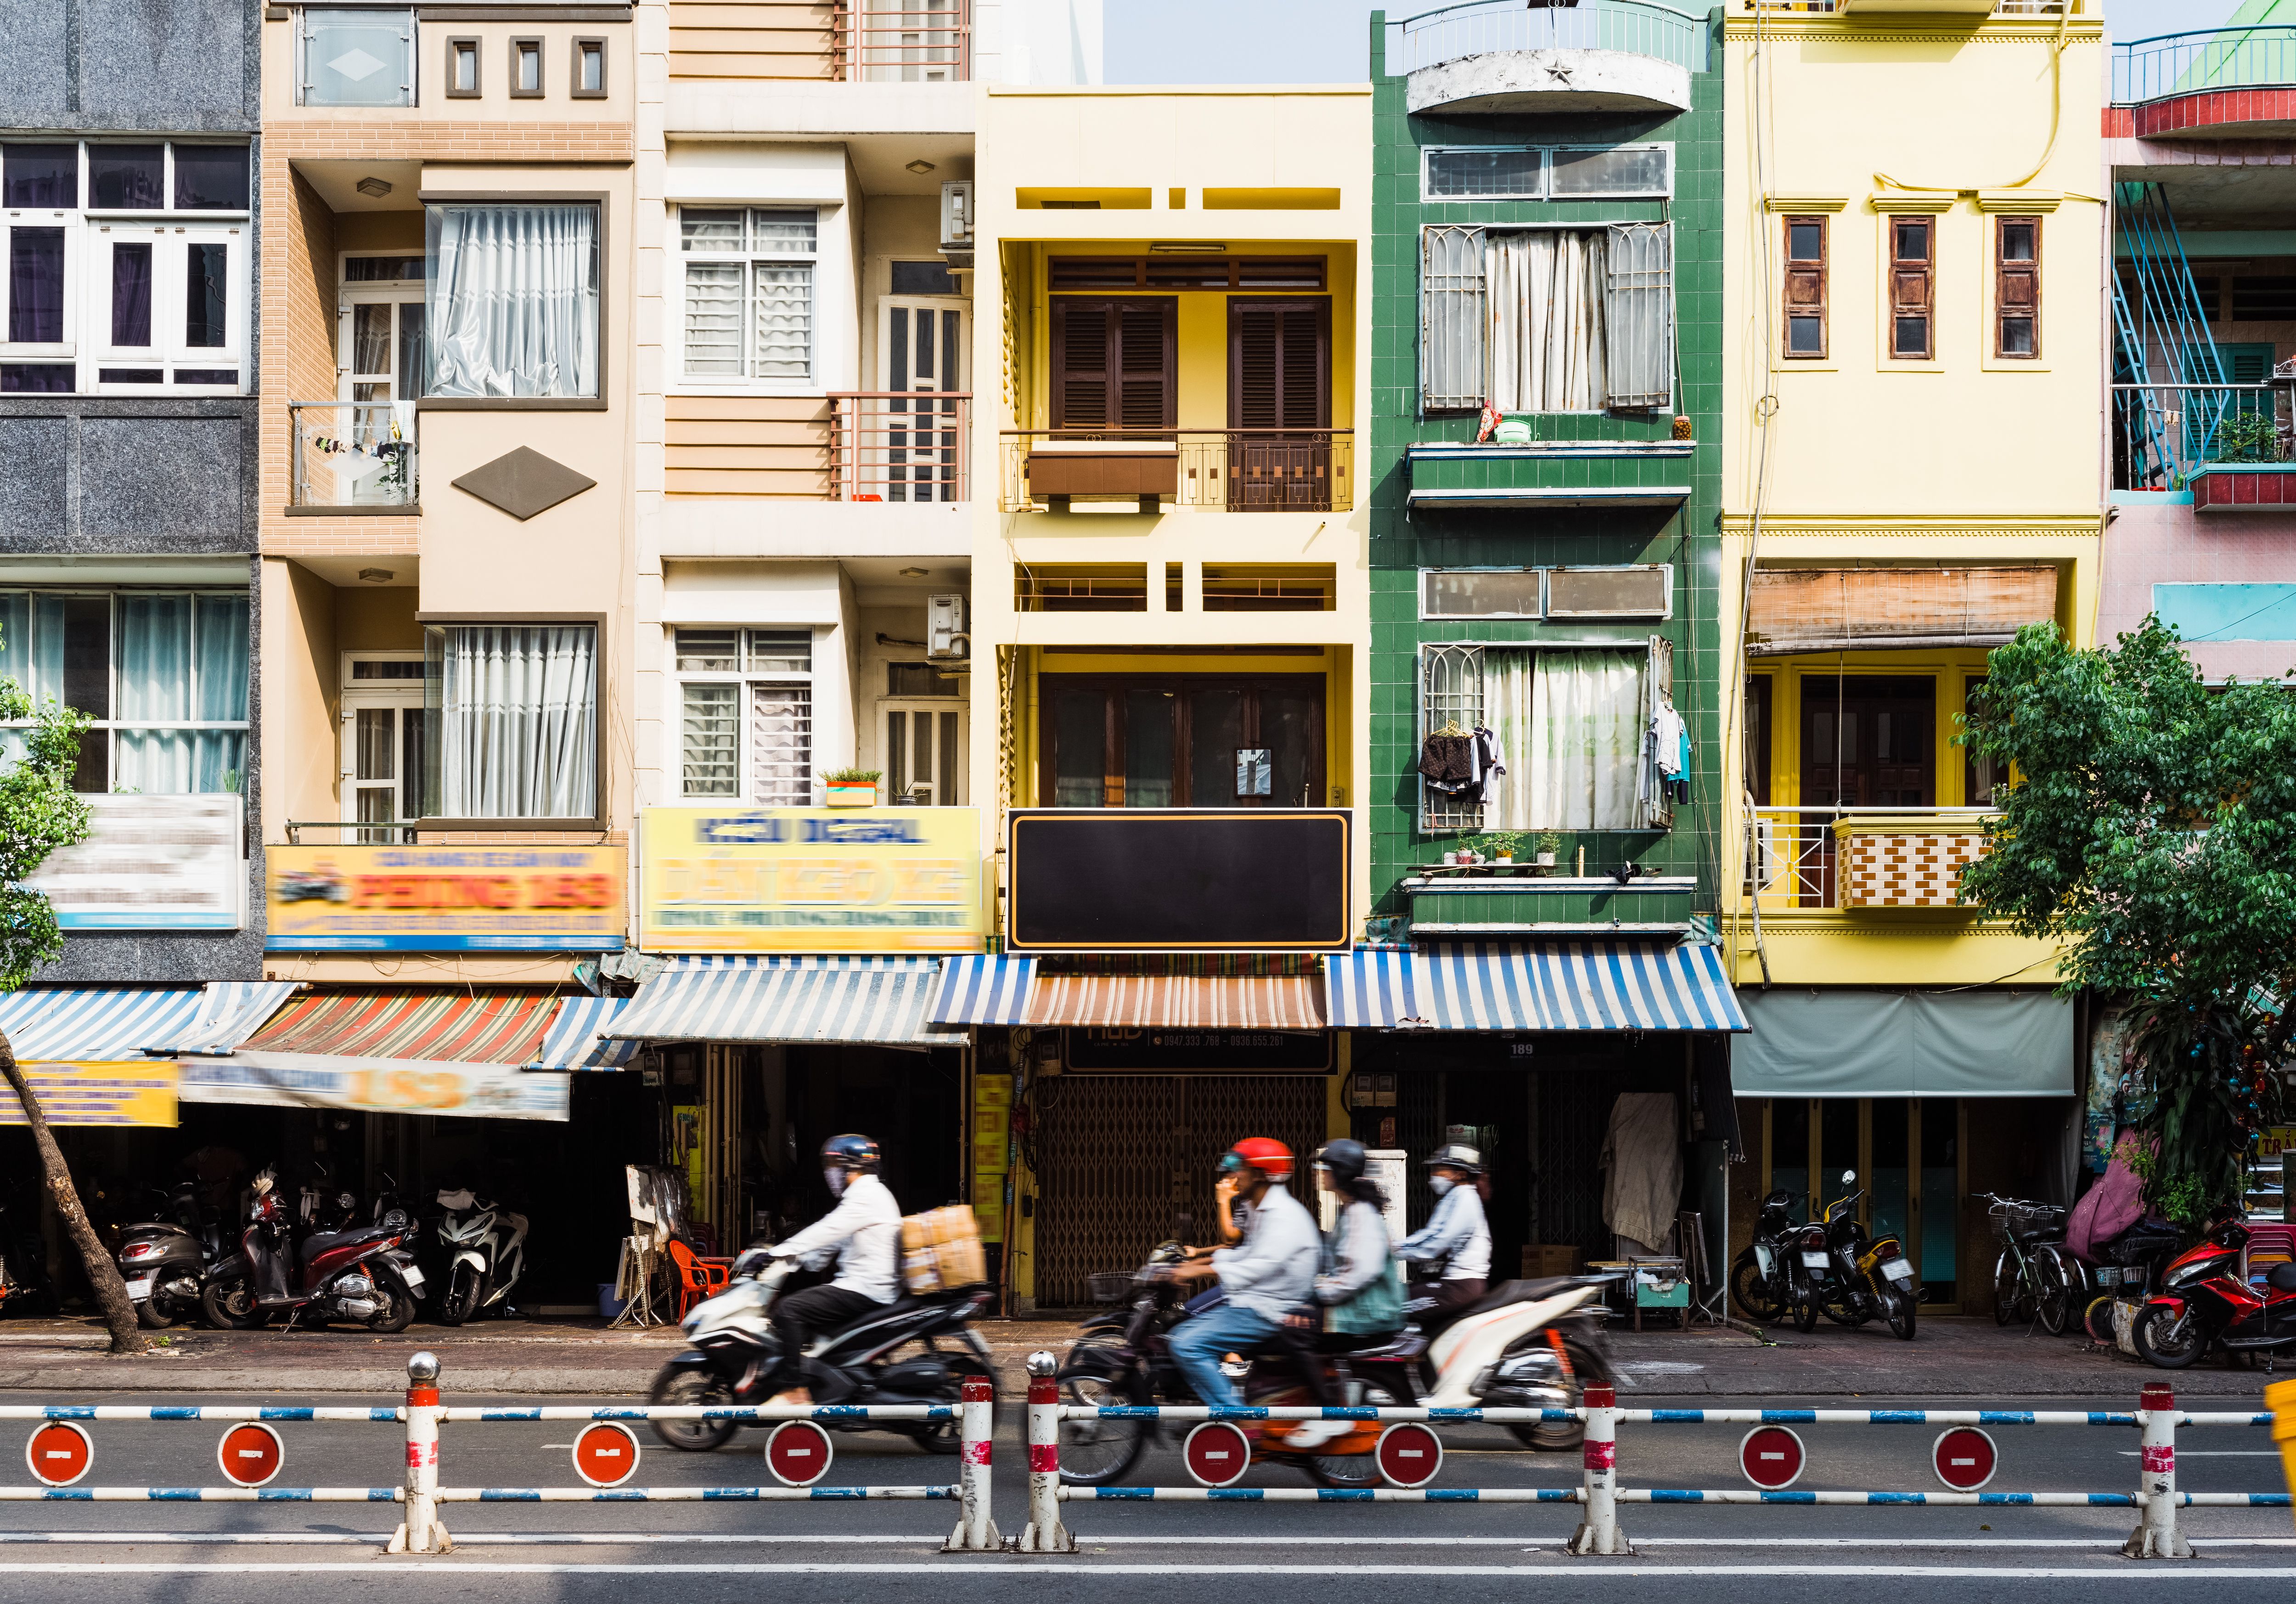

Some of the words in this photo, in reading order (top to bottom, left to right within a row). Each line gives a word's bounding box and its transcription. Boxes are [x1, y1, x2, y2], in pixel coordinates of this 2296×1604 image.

[1164, 1035, 1200, 1046] 0947.333
[1230, 1035, 1283, 1046] 0936.655.261
[1511, 1044, 1533, 1055] 189
[2262, 1129, 2296, 1155] TRẮ
